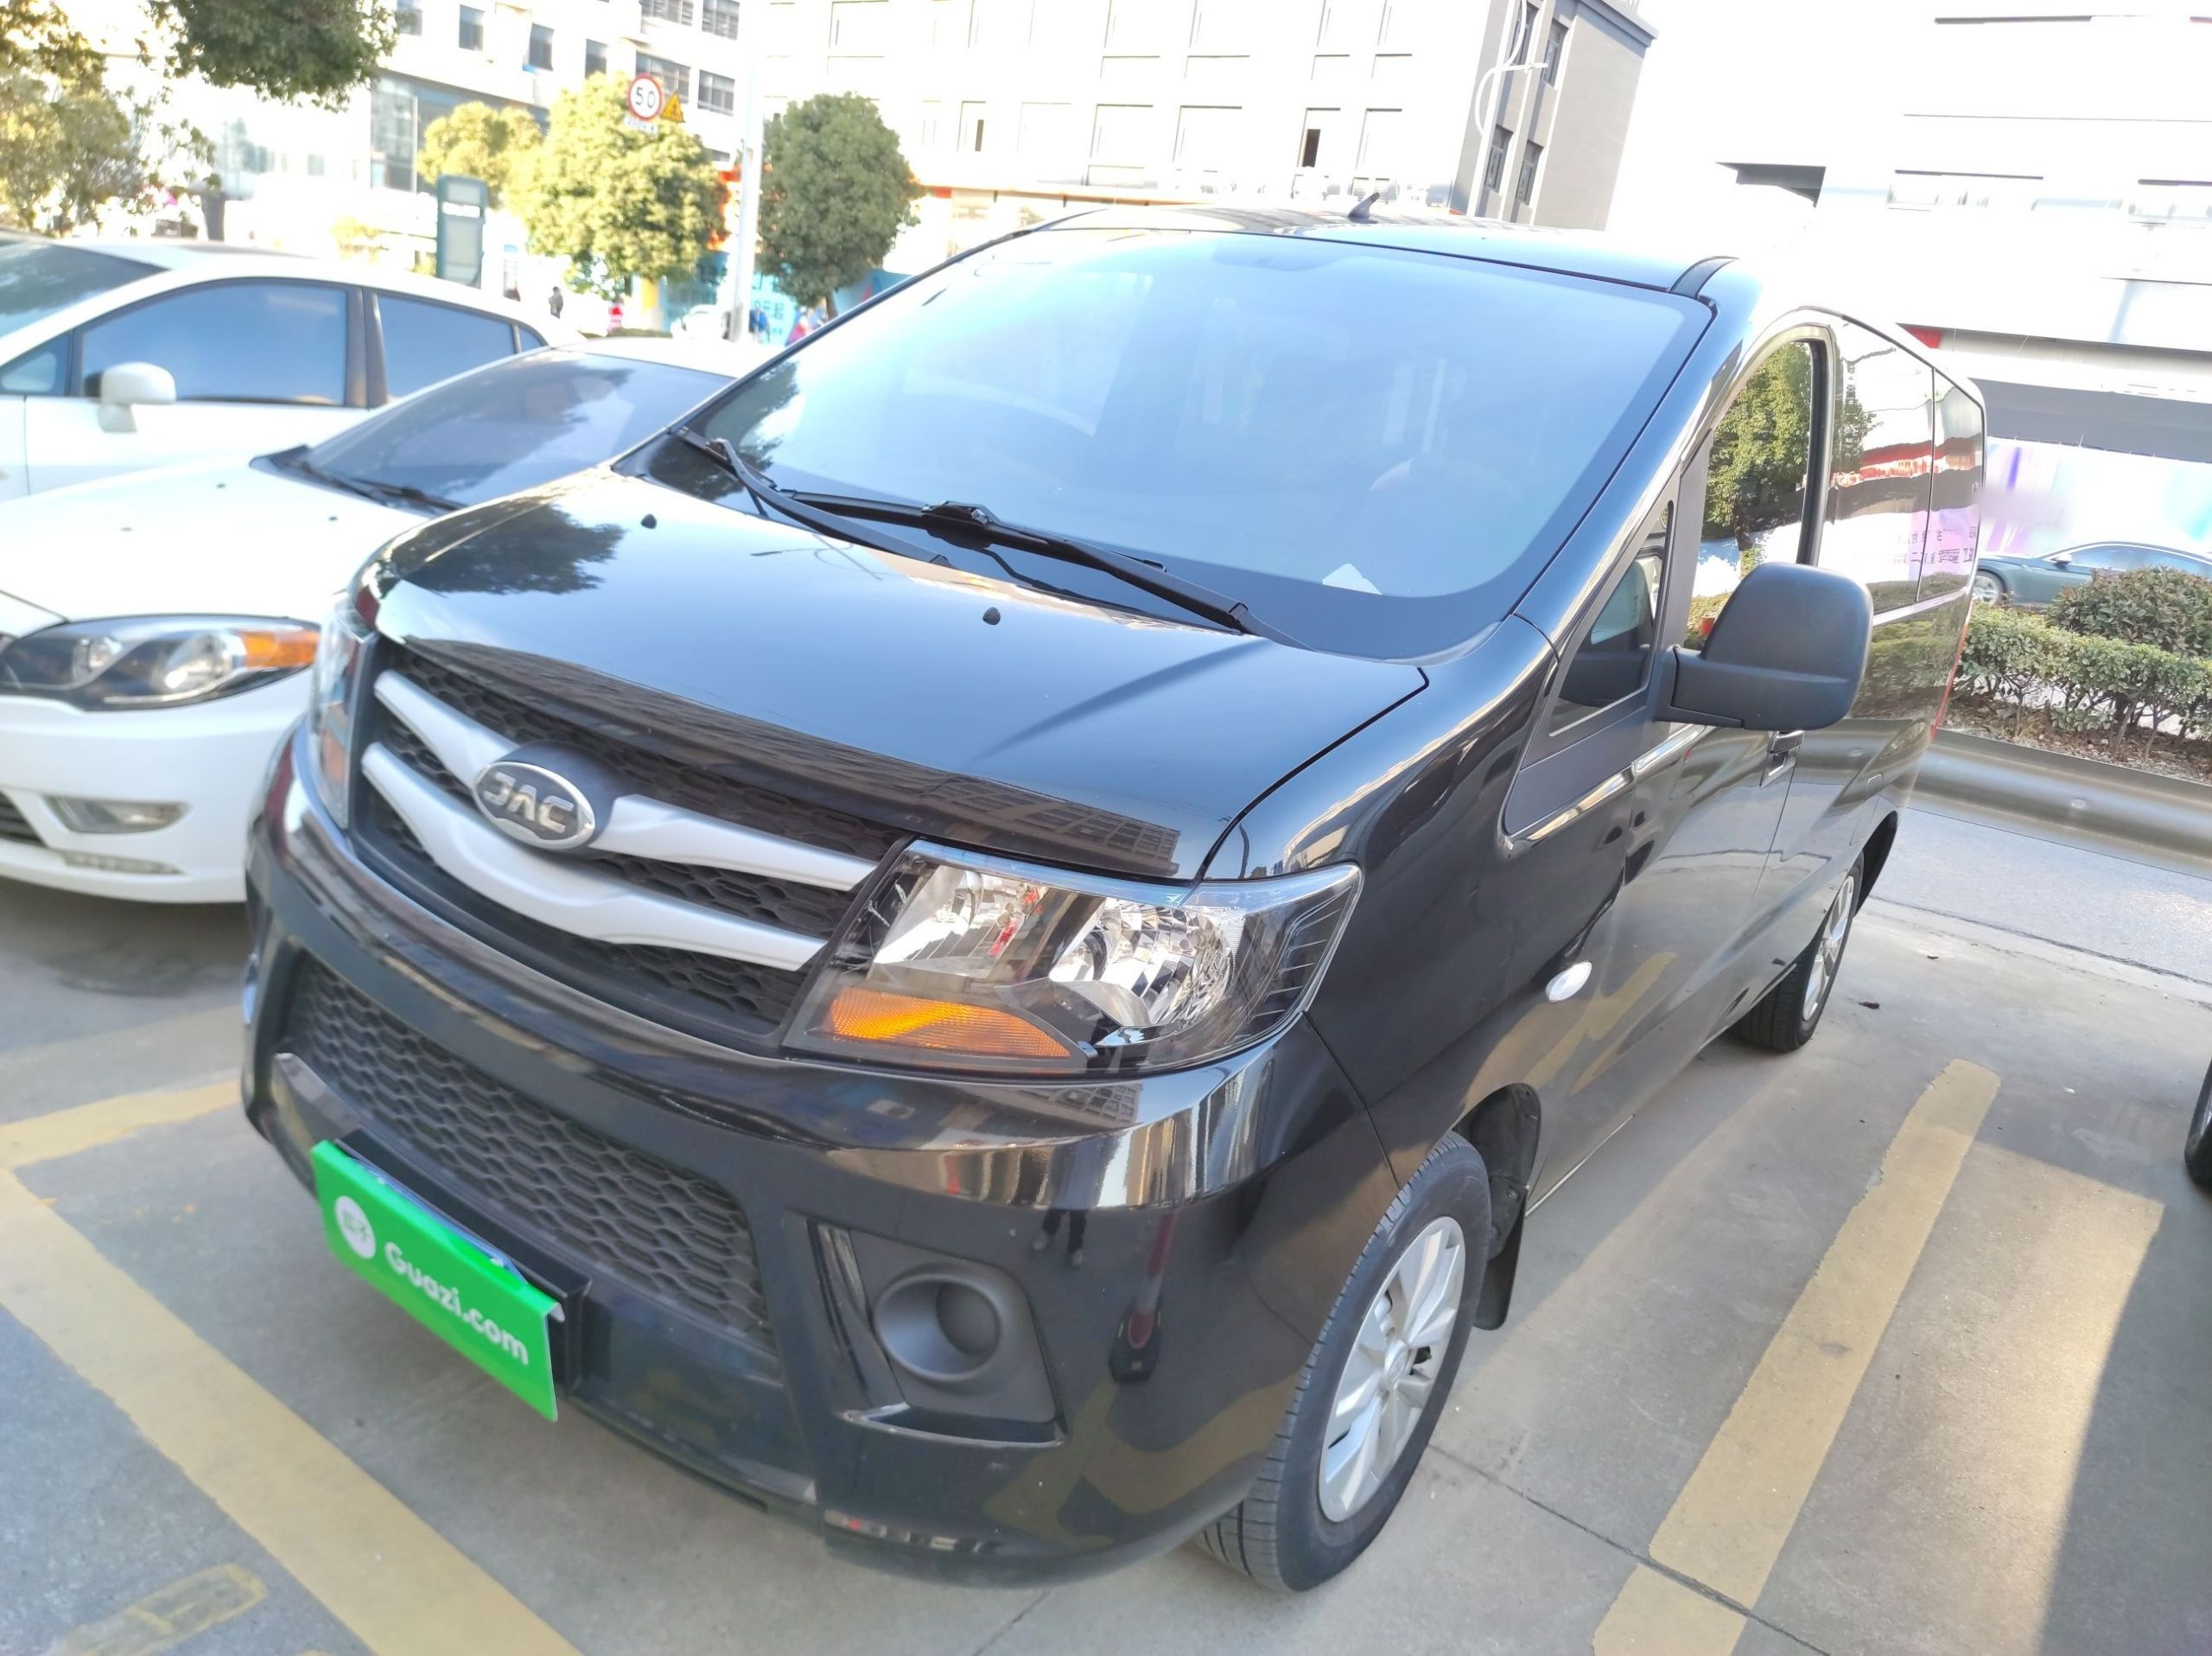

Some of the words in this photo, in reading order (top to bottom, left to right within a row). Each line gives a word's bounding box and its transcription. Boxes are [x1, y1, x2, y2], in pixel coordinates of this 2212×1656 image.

[635, 86, 656, 109] 50
[483, 771, 575, 833] JAC
[384, 1241, 529, 1366] Guazi.com
